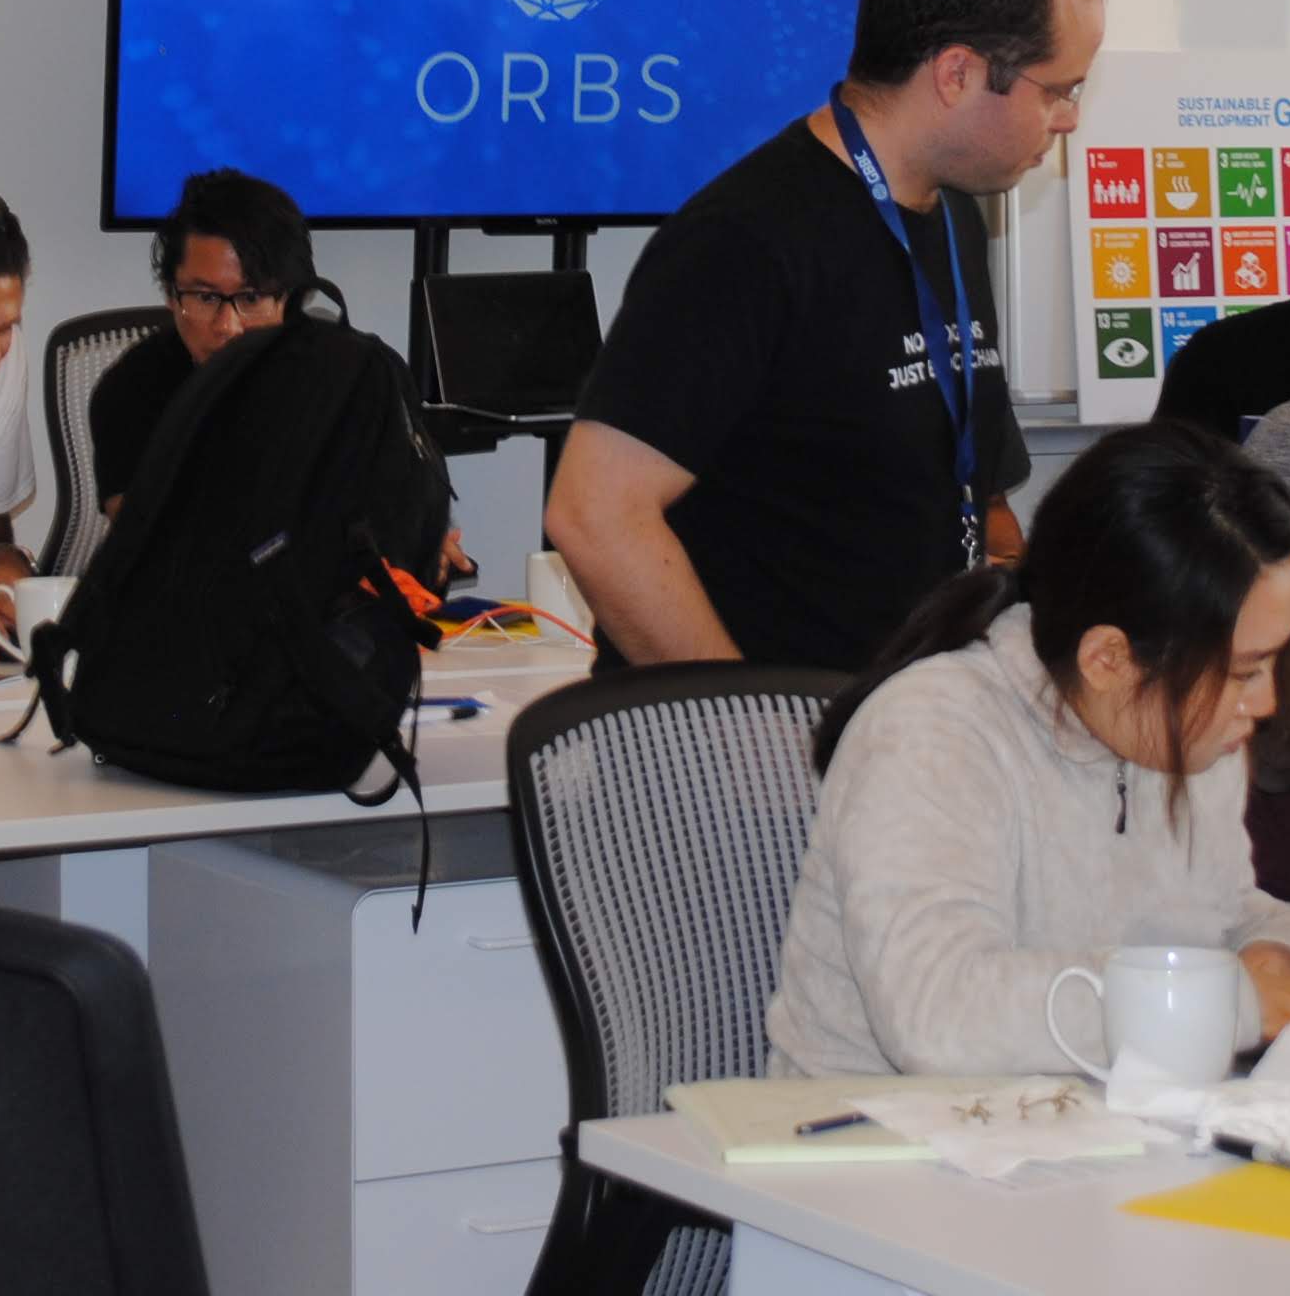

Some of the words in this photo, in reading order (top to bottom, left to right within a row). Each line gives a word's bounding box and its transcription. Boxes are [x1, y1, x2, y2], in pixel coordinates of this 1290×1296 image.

[416, 51, 681, 124] ORBS
[1177, 97, 1271, 111] SUSTAINABLE
[1178, 114, 1271, 128] DEVELOPMENT
[854, 149, 880, 184] GBBC
[1219, 152, 1229, 169] 3
[1096, 312, 1112, 329] 13
[888, 362, 926, 390] JUST
